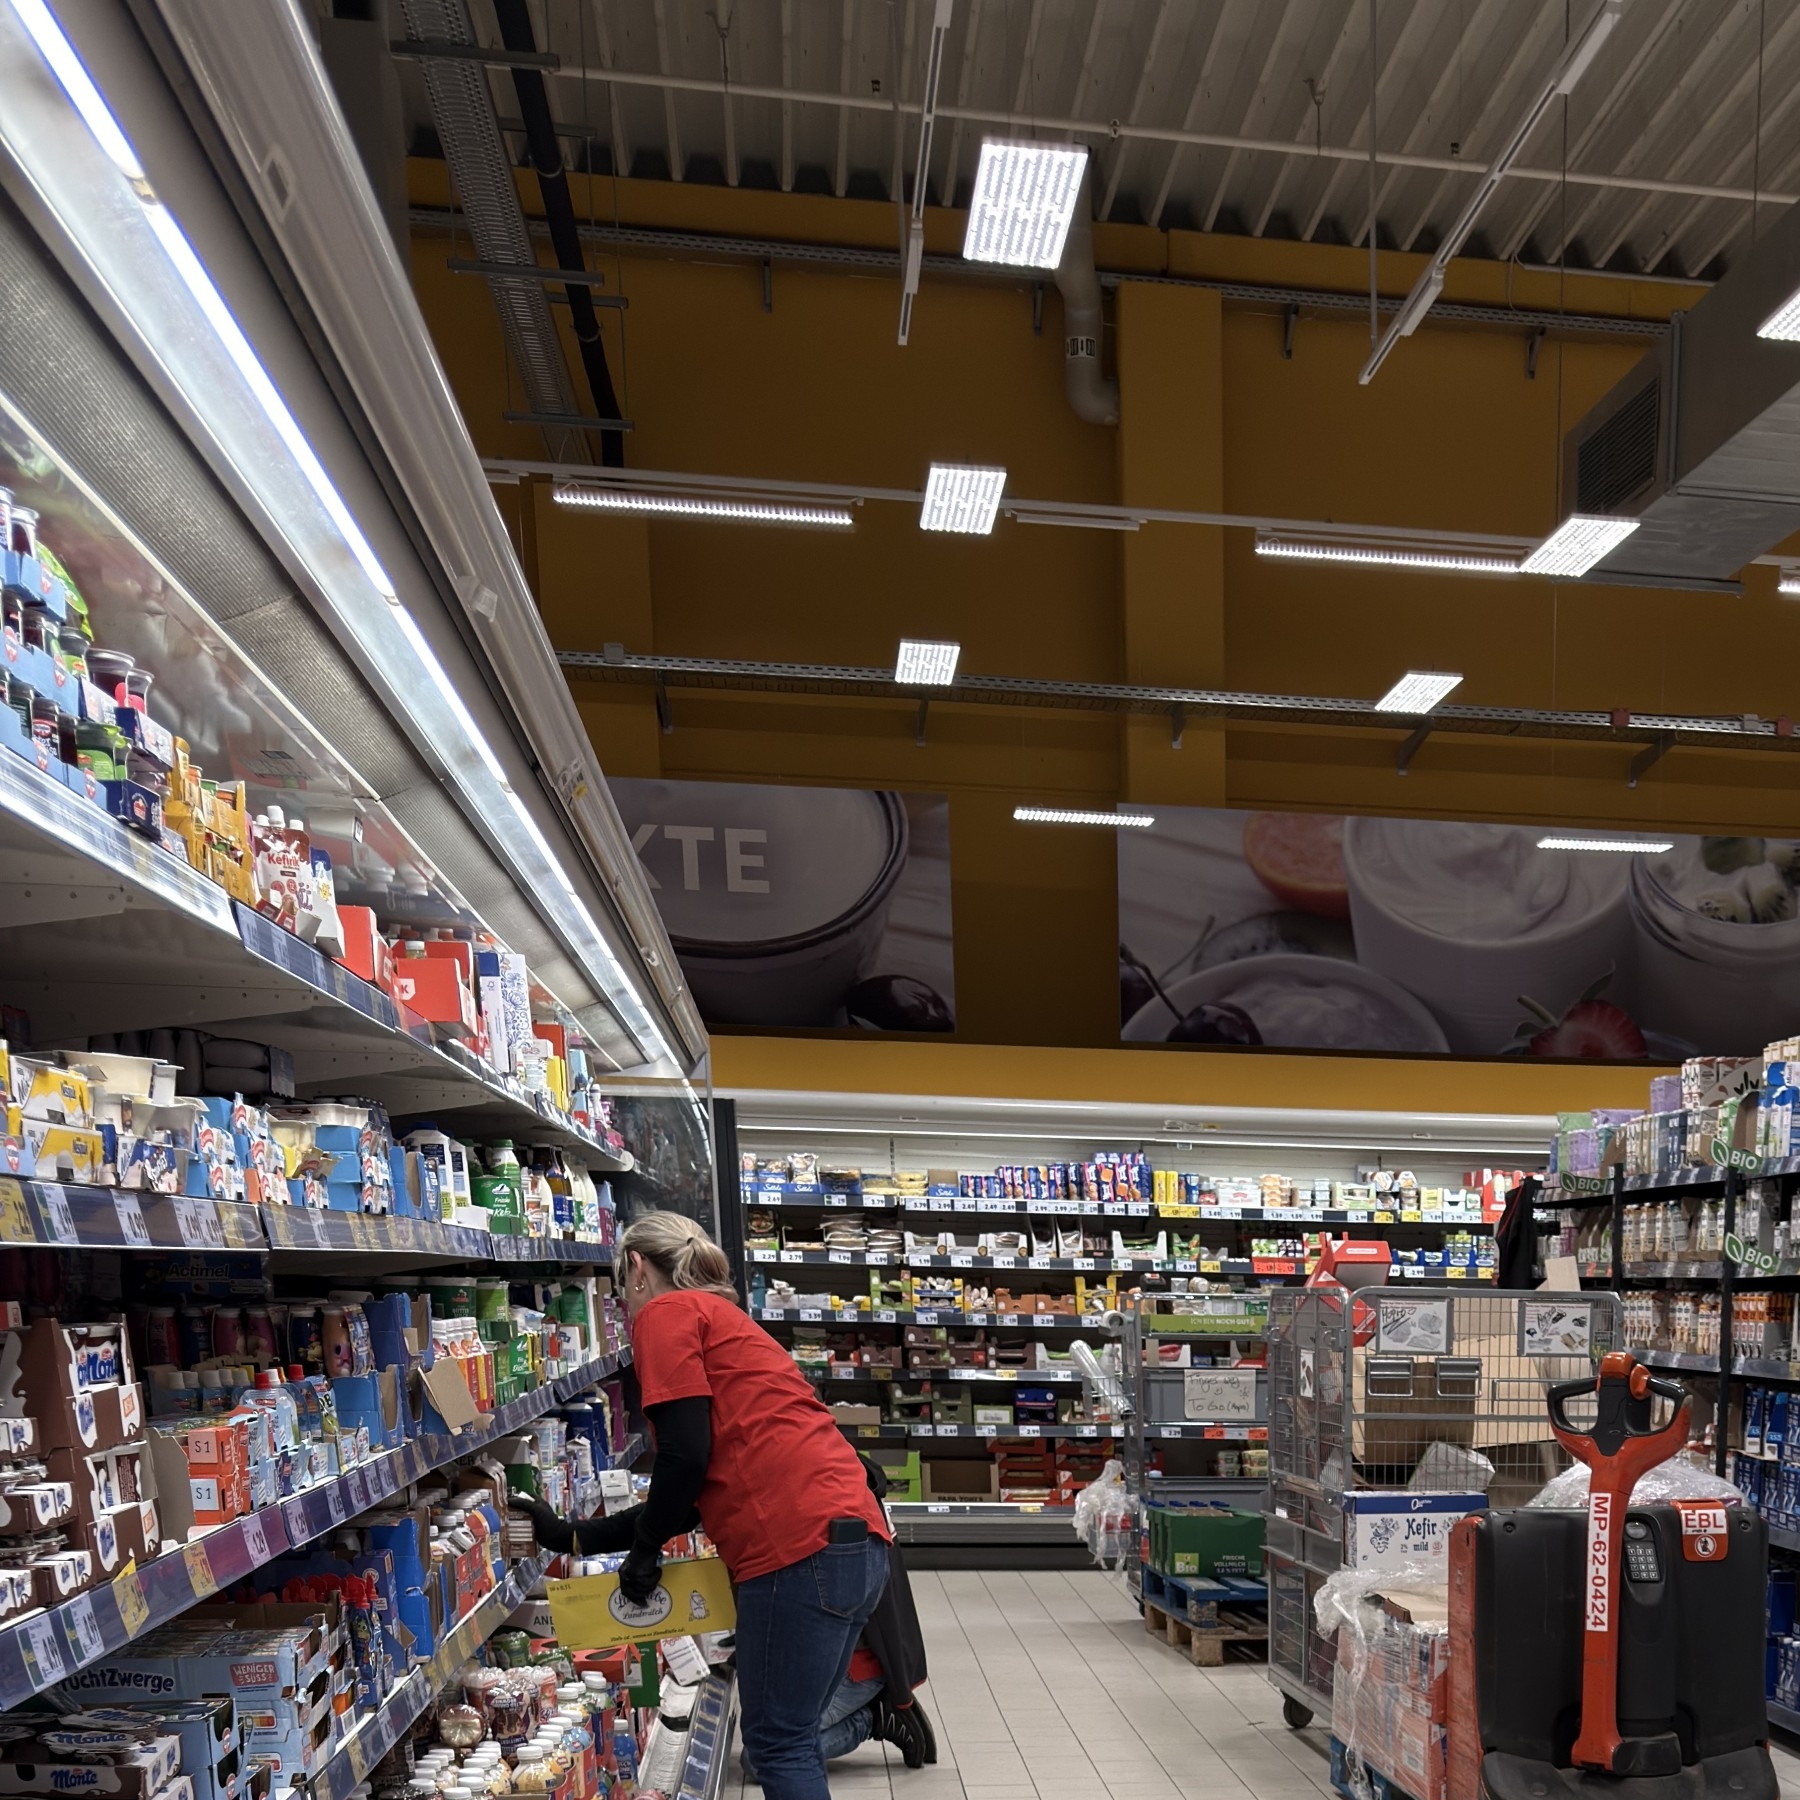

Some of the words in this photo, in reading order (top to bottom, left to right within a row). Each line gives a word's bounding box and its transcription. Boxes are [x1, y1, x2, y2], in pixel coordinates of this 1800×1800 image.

[1730, 1150, 1757, 1170] BIO
[1577, 1178, 1601, 1191] BIO
[1745, 1247, 1773, 1268] BIO
[168, 1264, 230, 1278] Actimel
[1188, 1398, 1206, 1411] To
[1208, 1401, 1226, 1411] Go
[1404, 1517, 1437, 1540] Kefir
[1685, 1512, 1724, 1529] EBL
[1413, 1541, 1428, 1551] mild
[1175, 1562, 1197, 1572] Bio
[1591, 1496, 1610, 1628] MP-62-0424
[42, 1634, 62, 1670] 0.99
[54, 1733, 128, 1745] Monte
[50, 1769, 98, 1789] Monte
